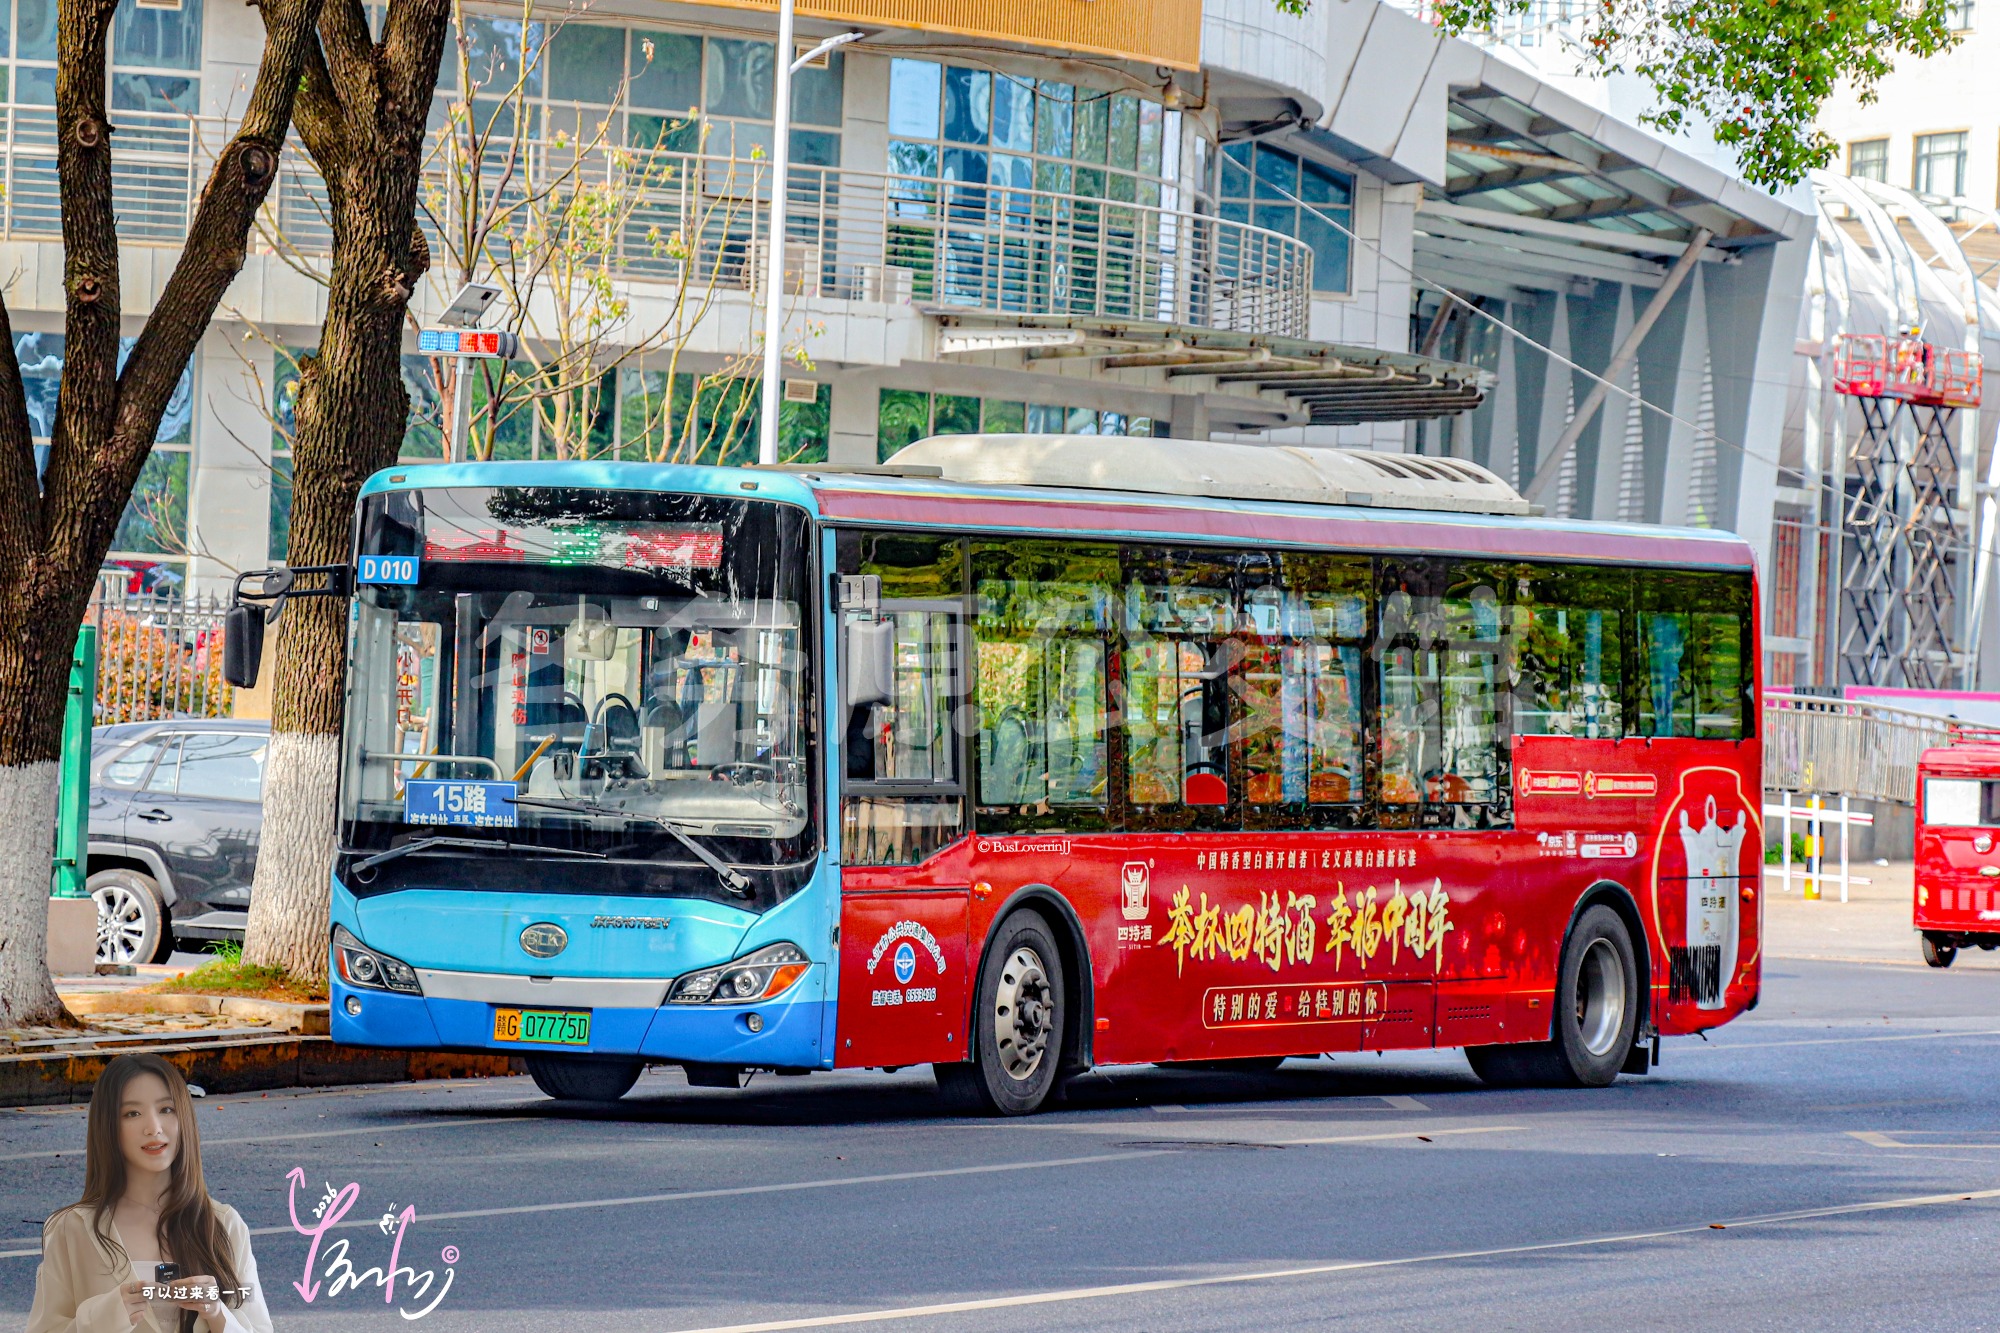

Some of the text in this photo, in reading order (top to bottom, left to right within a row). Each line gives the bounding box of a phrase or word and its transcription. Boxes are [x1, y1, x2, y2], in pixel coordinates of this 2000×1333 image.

[364, 559, 412, 580] D 010
[433, 785, 486, 813] 15路
[1197, 849, 1417, 871] 中国特香型白酒开创者 定义高端白酒新标准
[1118, 924, 1152, 941] 四特酒
[1156, 877, 1455, 980] 举杯四特酒 幸福中国年
[1213, 990, 1278, 1022] 特别的爱
[1298, 988, 1378, 1018] 给特别的你
[526, 1015, 588, 1040] 07775D
